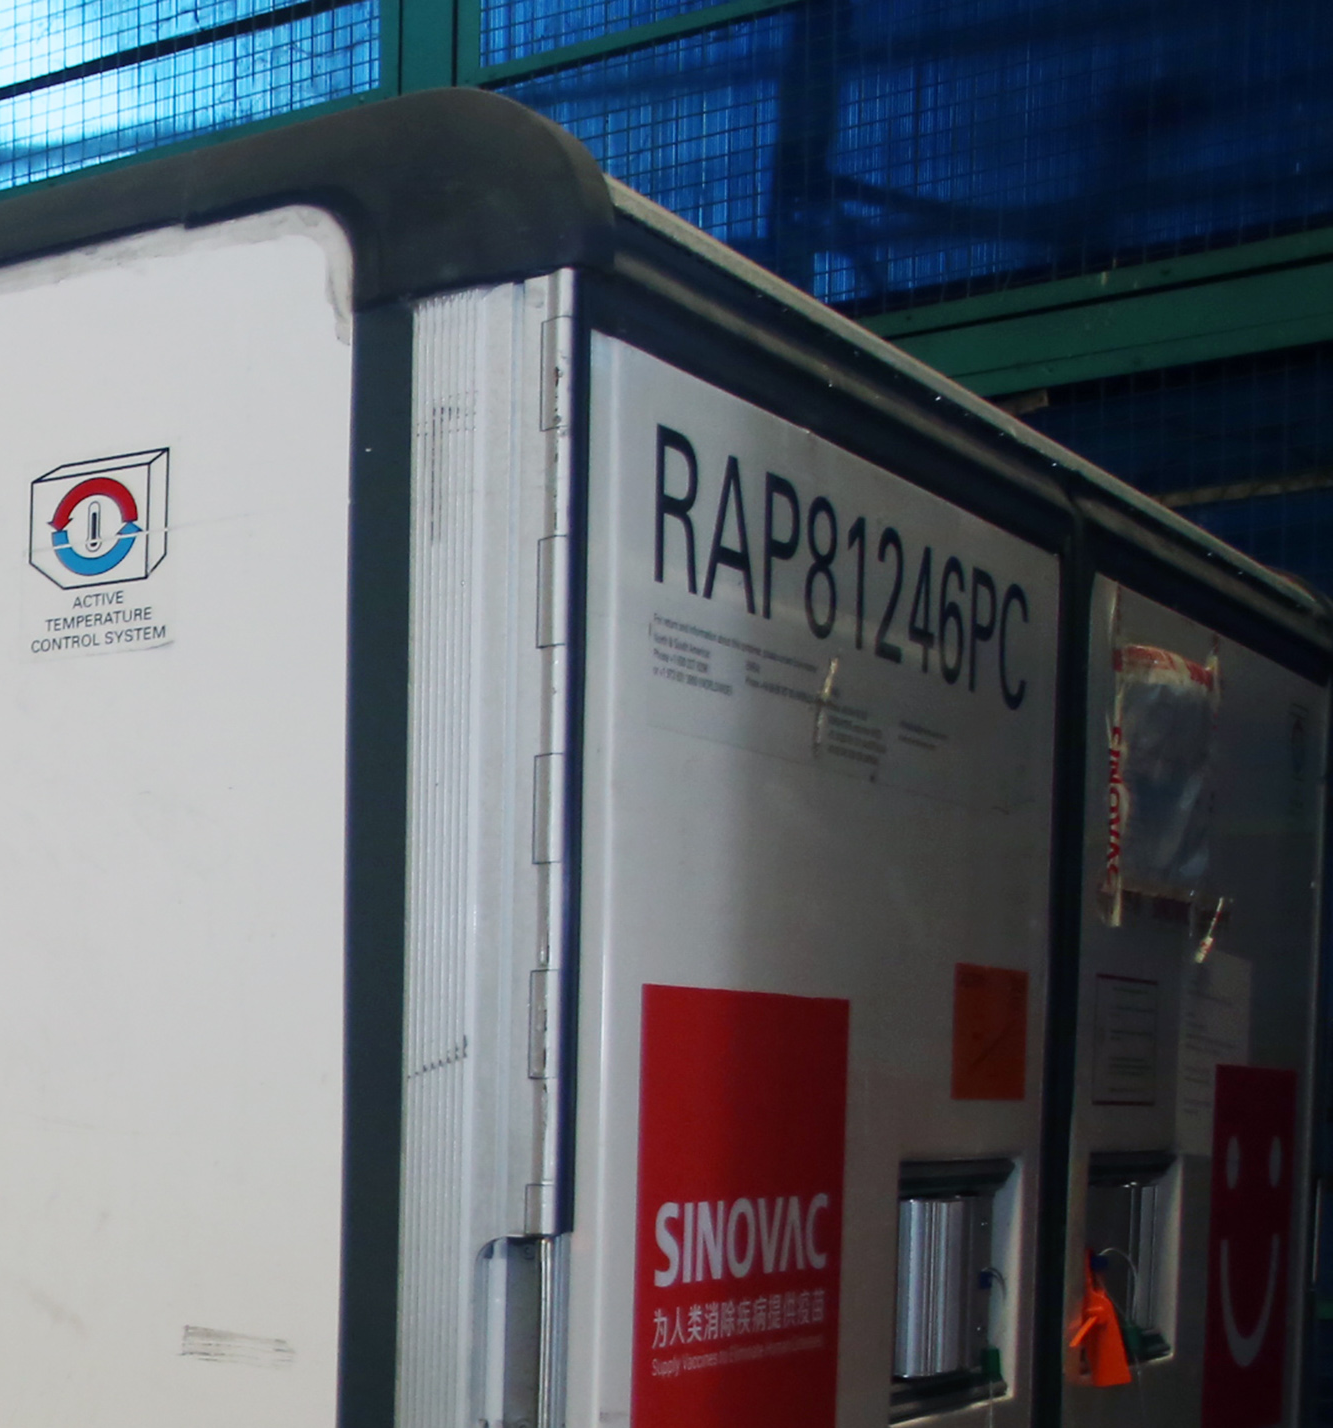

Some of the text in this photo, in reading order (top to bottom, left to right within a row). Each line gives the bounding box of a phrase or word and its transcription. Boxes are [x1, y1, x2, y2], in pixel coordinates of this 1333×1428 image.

[654, 423, 1030, 711] RAP81246PC
[72, 590, 124, 610] ACTIVE
[45, 606, 153, 633] TEMPERATURE
[30, 624, 167, 654] CONTROL SYSTEM
[653, 1191, 829, 1289] SINOVAC
